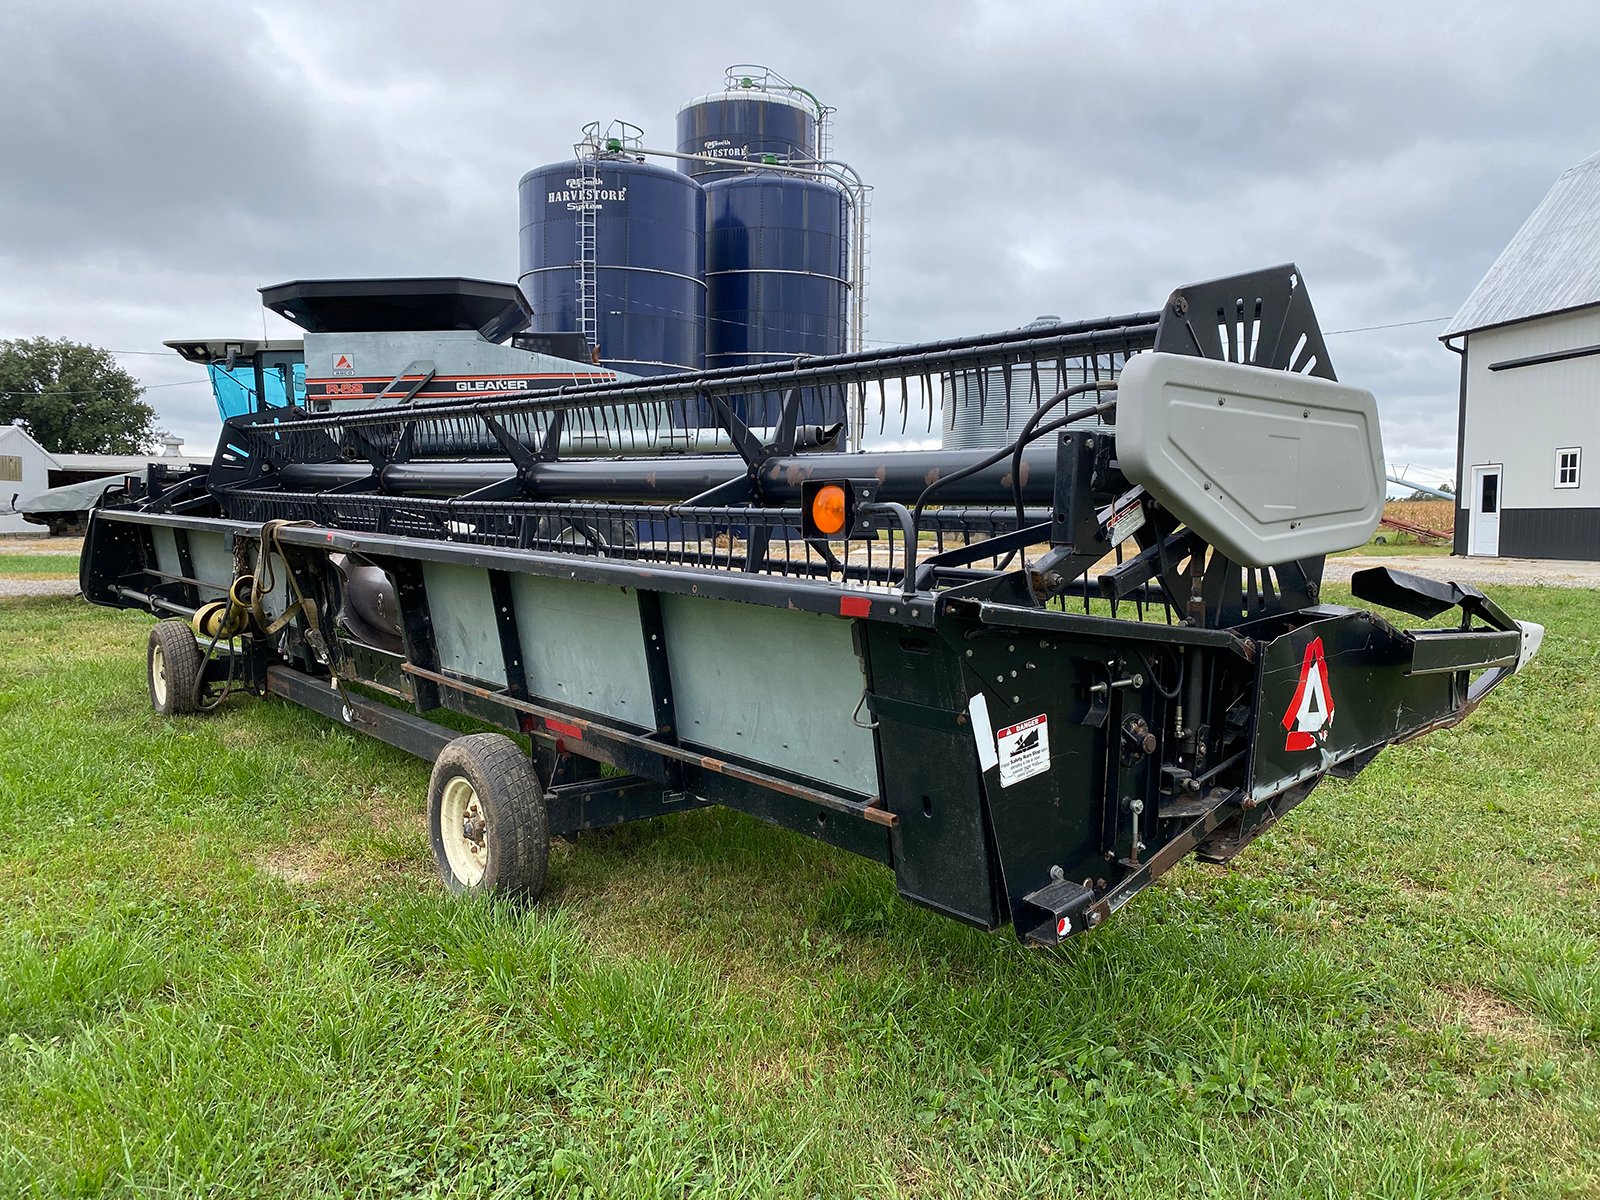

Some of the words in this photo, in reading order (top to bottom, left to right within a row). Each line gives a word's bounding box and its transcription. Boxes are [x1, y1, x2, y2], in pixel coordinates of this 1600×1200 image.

[548, 190, 626, 203] HARVESTORE
[456, 380, 529, 391] GLEANER
[1015, 718, 1039, 732] DANGER
